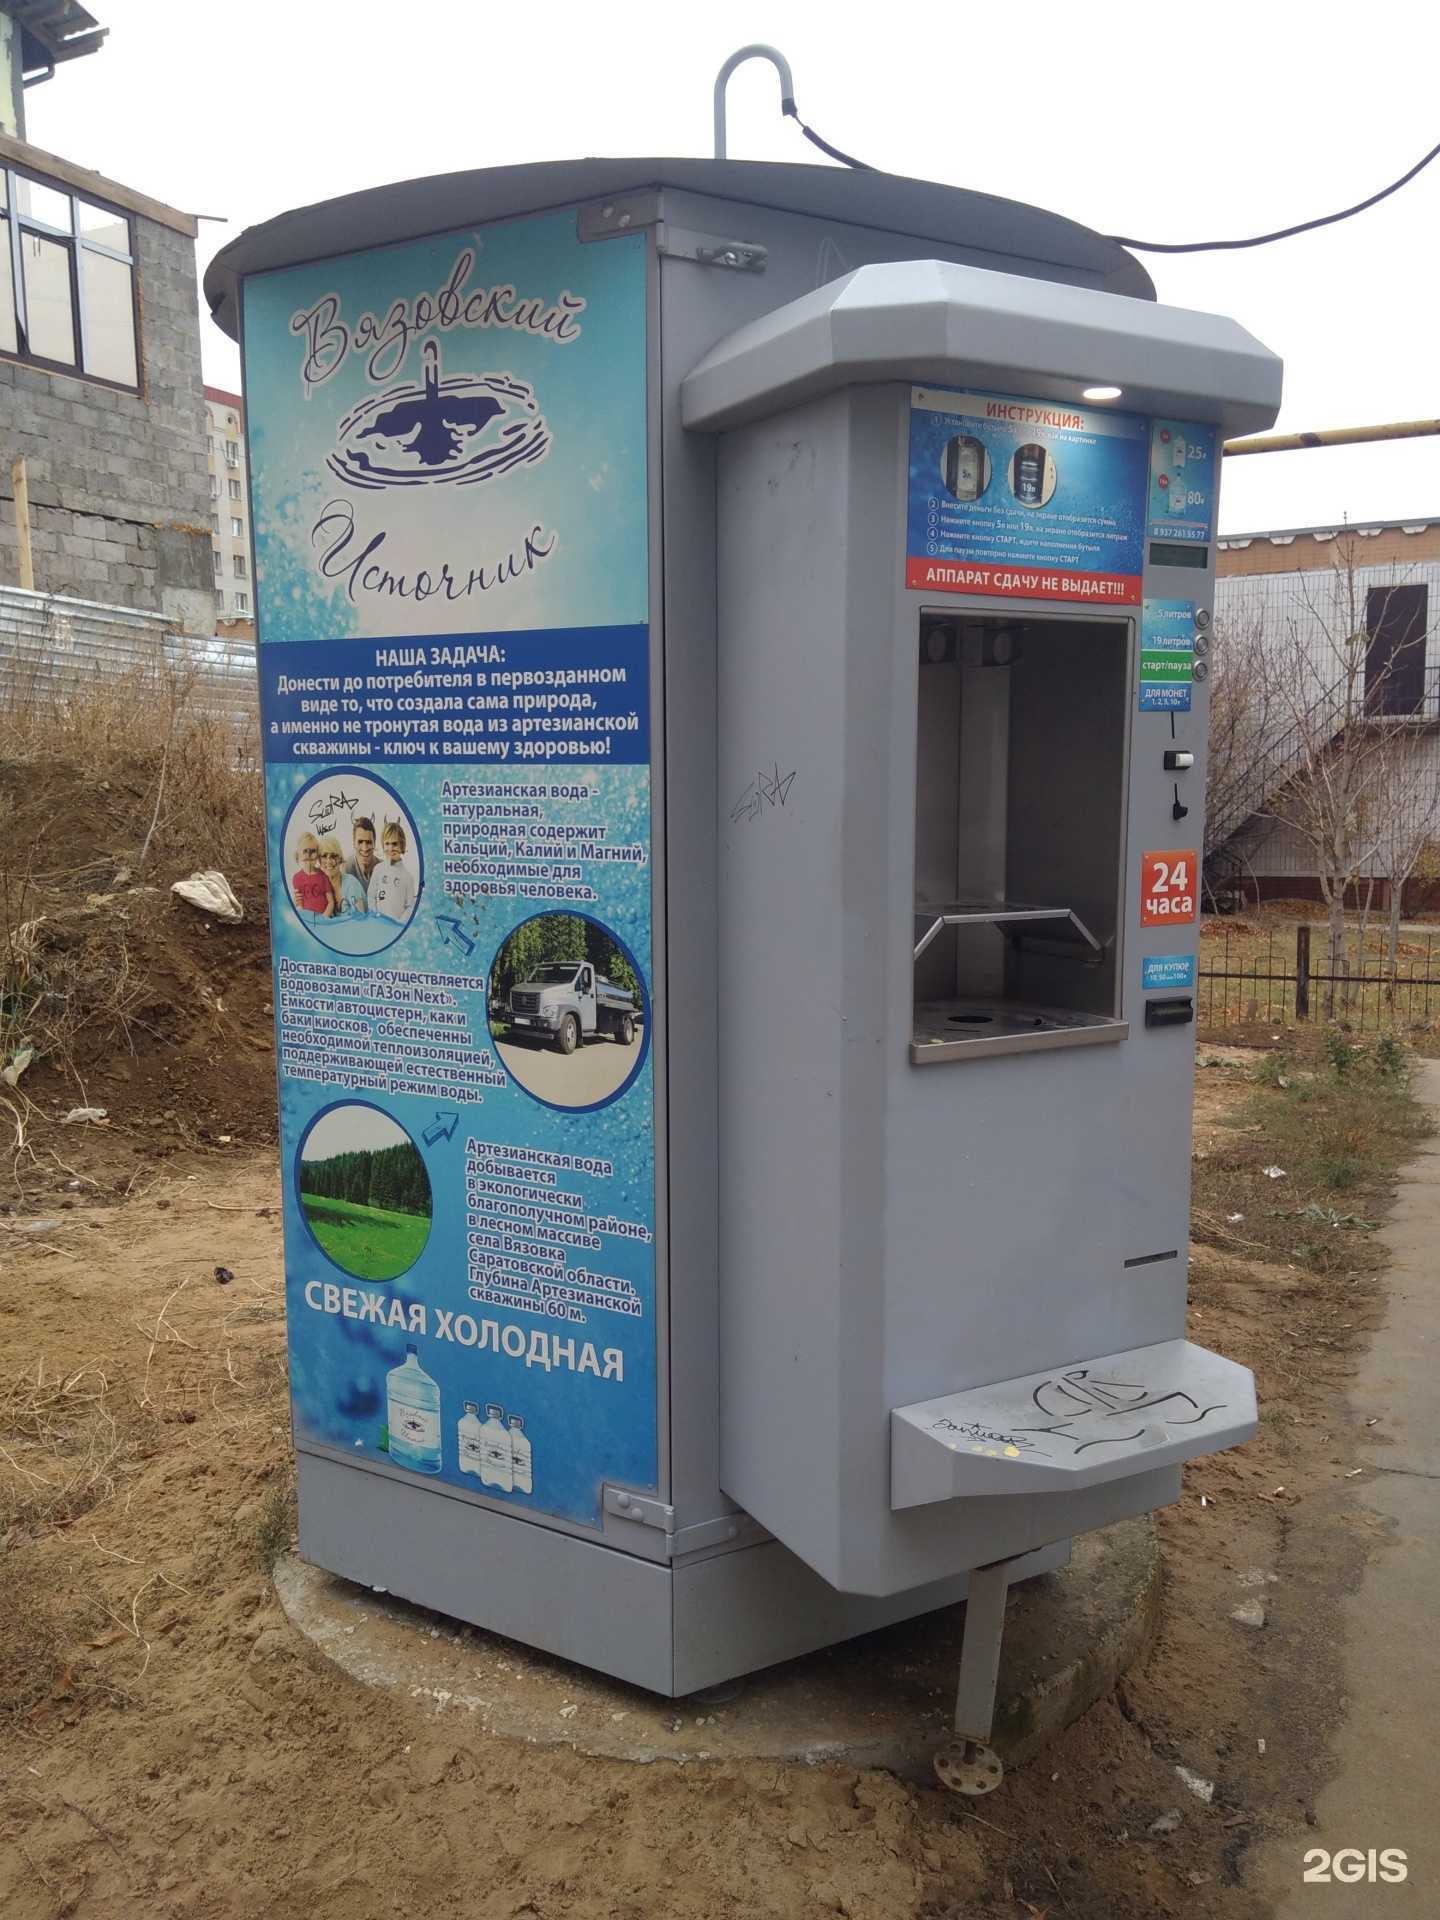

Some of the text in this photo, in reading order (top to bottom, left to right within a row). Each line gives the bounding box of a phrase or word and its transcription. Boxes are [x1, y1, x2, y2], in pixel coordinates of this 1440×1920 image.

[293, 252, 583, 392] Вязовский
[986, 402, 1085, 430] ИНСТРУКЦИЯ:
[311, 498, 556, 602] Источник
[1060, 555, 1080, 564] СТАРТ
[926, 567, 1125, 596] АППАРАТ СДАЧУ НЕ ВЫДАЕТ!!!
[1163, 610, 1191, 618] литров
[1152, 636, 1191, 646] 19 литров
[375, 645, 506, 668] НАША ЗАДАЧА:
[1142, 661, 1191, 672] старт/пауза
[277, 668, 626, 695] Донести до потребителя в первозданном
[1145, 689, 1187, 697] ДЛЯ МОНЕТ
[301, 692, 597, 716] виде то, что создала сама природа,
[271, 712, 639, 739] а именно не тронутая вода из артезианской
[293, 740, 371, 756] скважины
[384, 741, 426, 755] ключ
[430, 741, 439, 755] к
[443, 739, 509, 759] вашему
[514, 737, 611, 758] здоровью!
[442, 781, 546, 800] Артезианская
[551, 784, 588, 800] вода
[443, 802, 543, 819] натуральная,
[443, 821, 606, 842] природная содержит
[444, 840, 648, 864] Кальций, Калий и Магний,
[444, 860, 580, 881] необходимые для
[1152, 862, 1188, 893] 24
[445, 880, 597, 900] здоровья человека.
[1146, 896, 1192, 915] часа
[280, 958, 484, 991] Доставка воды осуществляется
[280, 979, 458, 1006] водовозами «ГАЗон Next».
[281, 993, 466, 1025] Емкости автоцистерн, как и
[281, 1010, 472, 1045] баки киосков, обеспеченны
[282, 1029, 496, 1068] необходимой теплоизоляцией,
[283, 1047, 506, 1087] поддерживающей естественный
[284, 1064, 483, 1103] температурный режим воды.
[466, 1138, 613, 1176] Артезианская вода
[467, 1159, 556, 1185] добывается
[468, 1178, 583, 1208] в экологически
[468, 1194, 653, 1242] благополучном районе,
[469, 1215, 601, 1250] в лесном массиве
[469, 1232, 565, 1261] села Вязовка
[468, 1248, 635, 1294] Саратовской области.
[469, 1267, 642, 1316] Глубина Артезианской
[469, 1287, 587, 1323] скважины 60 м.
[304, 1280, 625, 1383] СВЕЖАЯ ХОЛОДНАЯ
